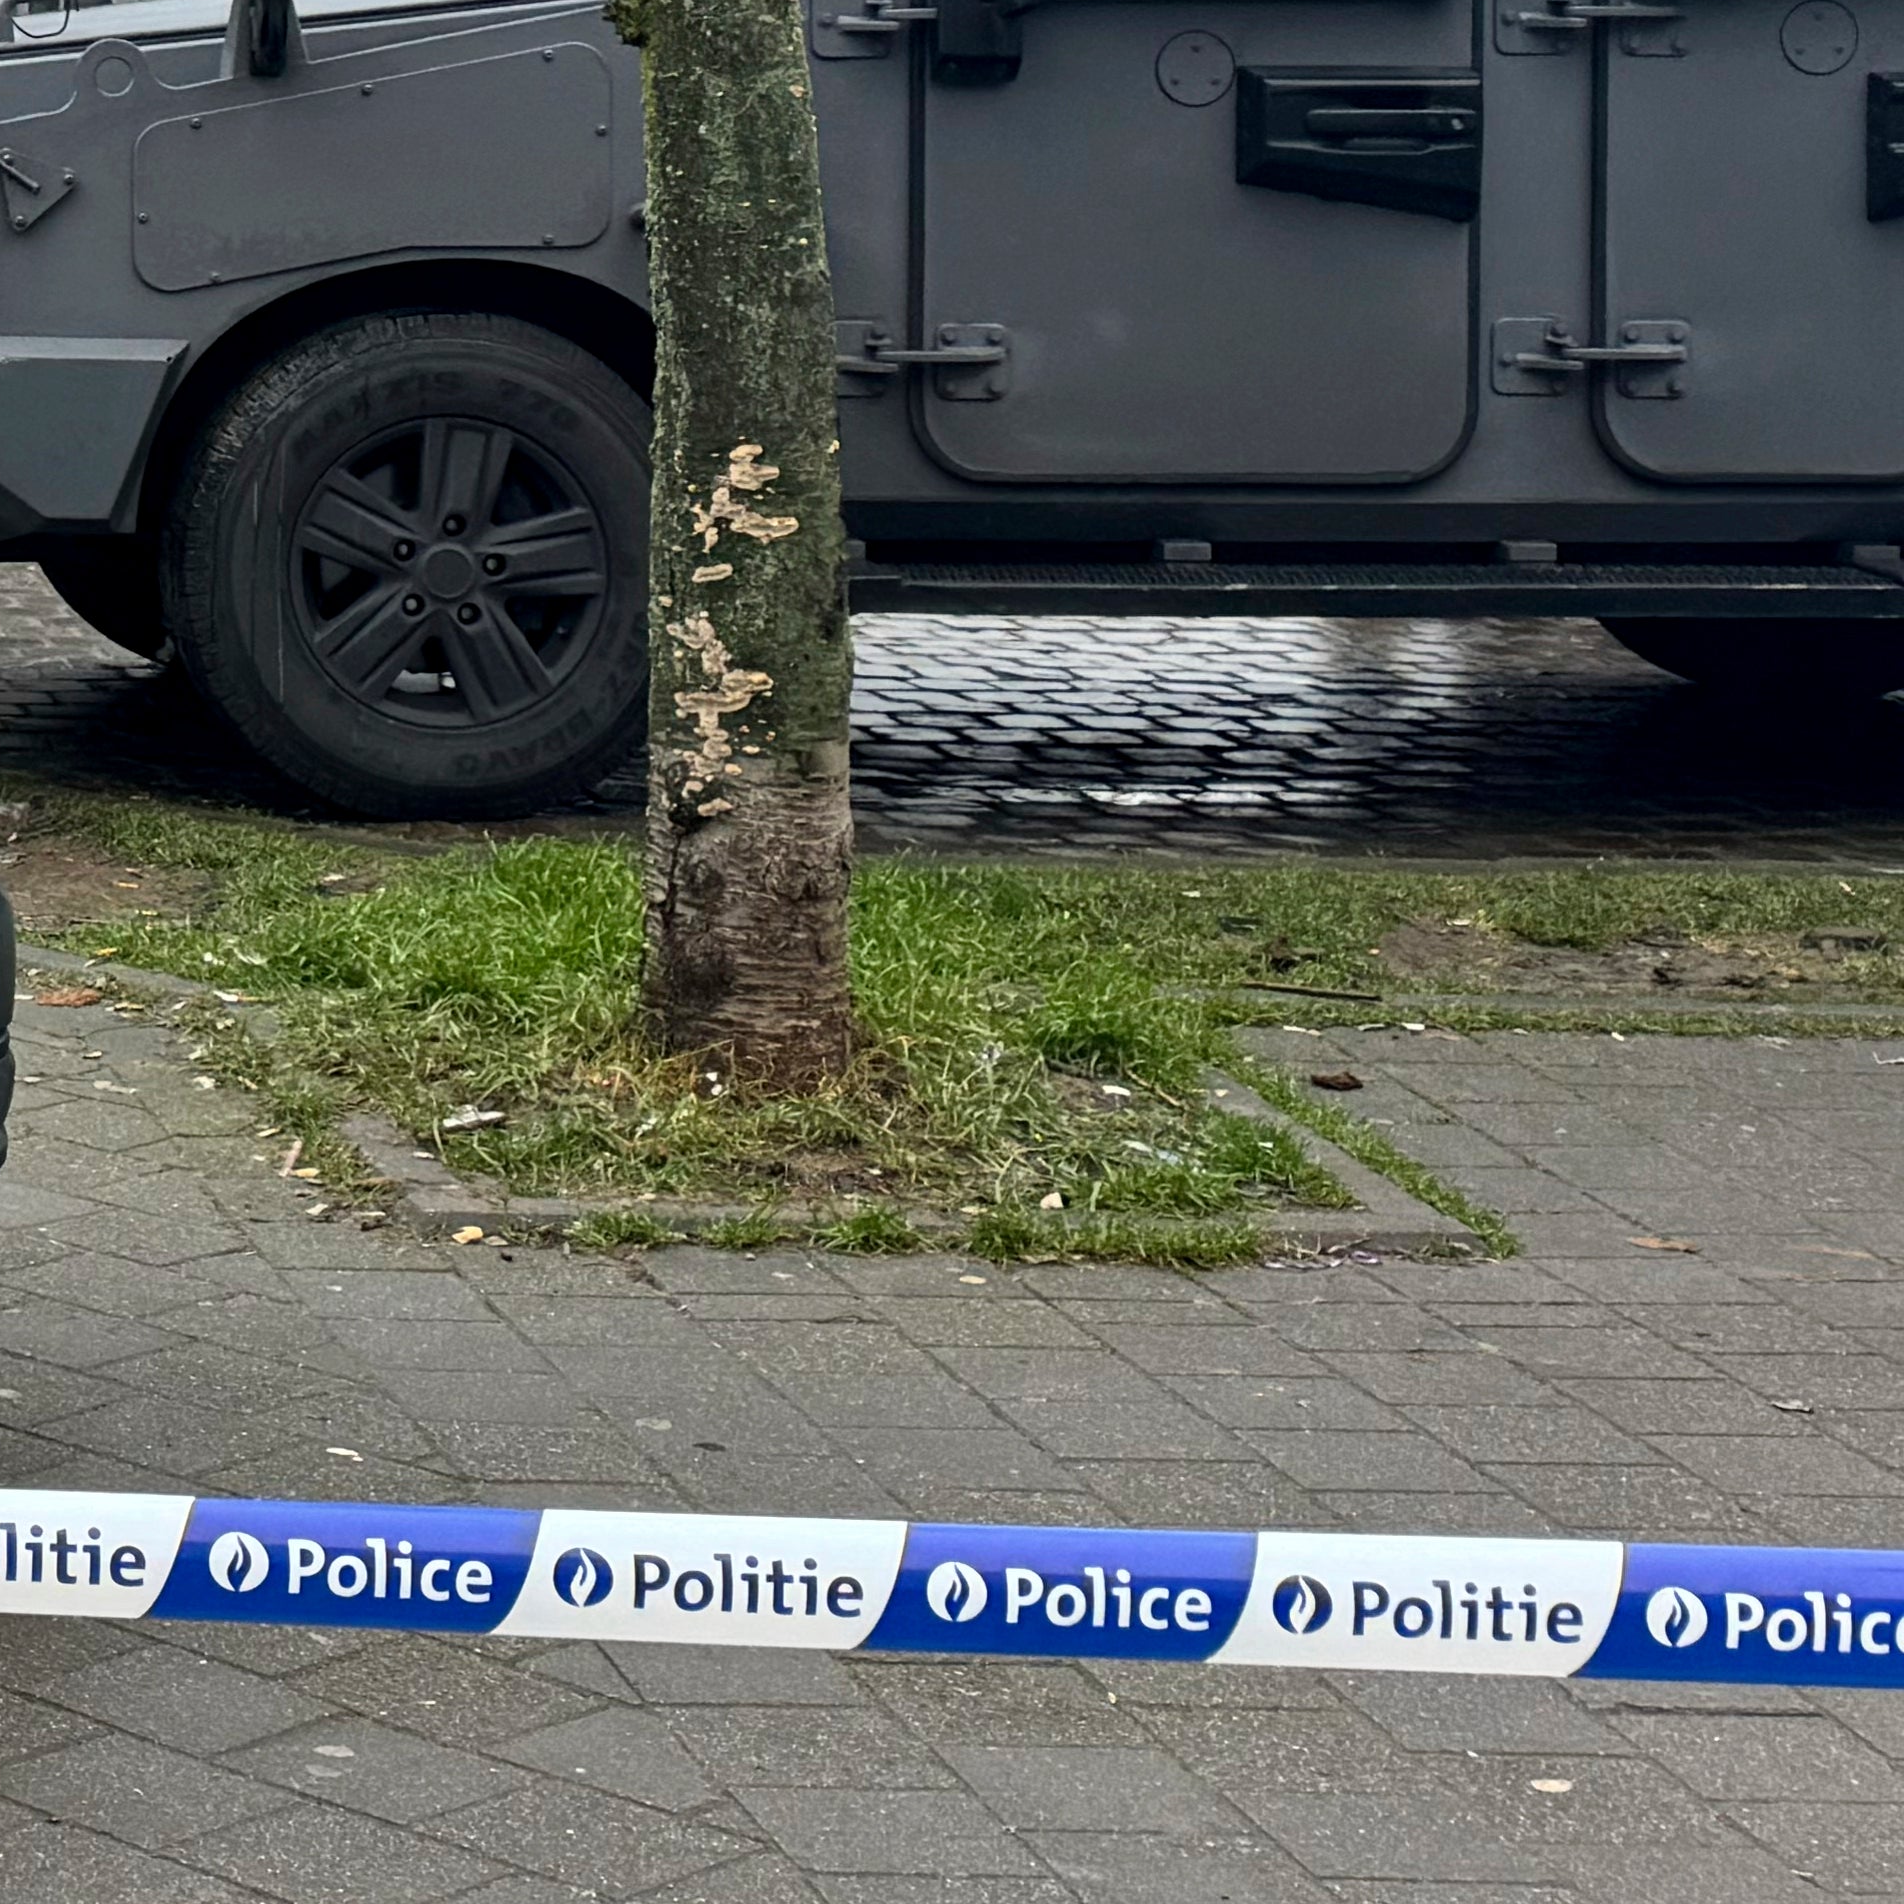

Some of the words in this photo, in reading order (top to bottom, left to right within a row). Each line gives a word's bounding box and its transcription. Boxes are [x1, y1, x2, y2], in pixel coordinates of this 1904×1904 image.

[286, 1536, 494, 1604] Police
[632, 1552, 865, 1619] Politie
[1004, 1565, 1213, 1632] Police
[1351, 1579, 1584, 1645] Politie
[1724, 1589, 1904, 1655] Polic
